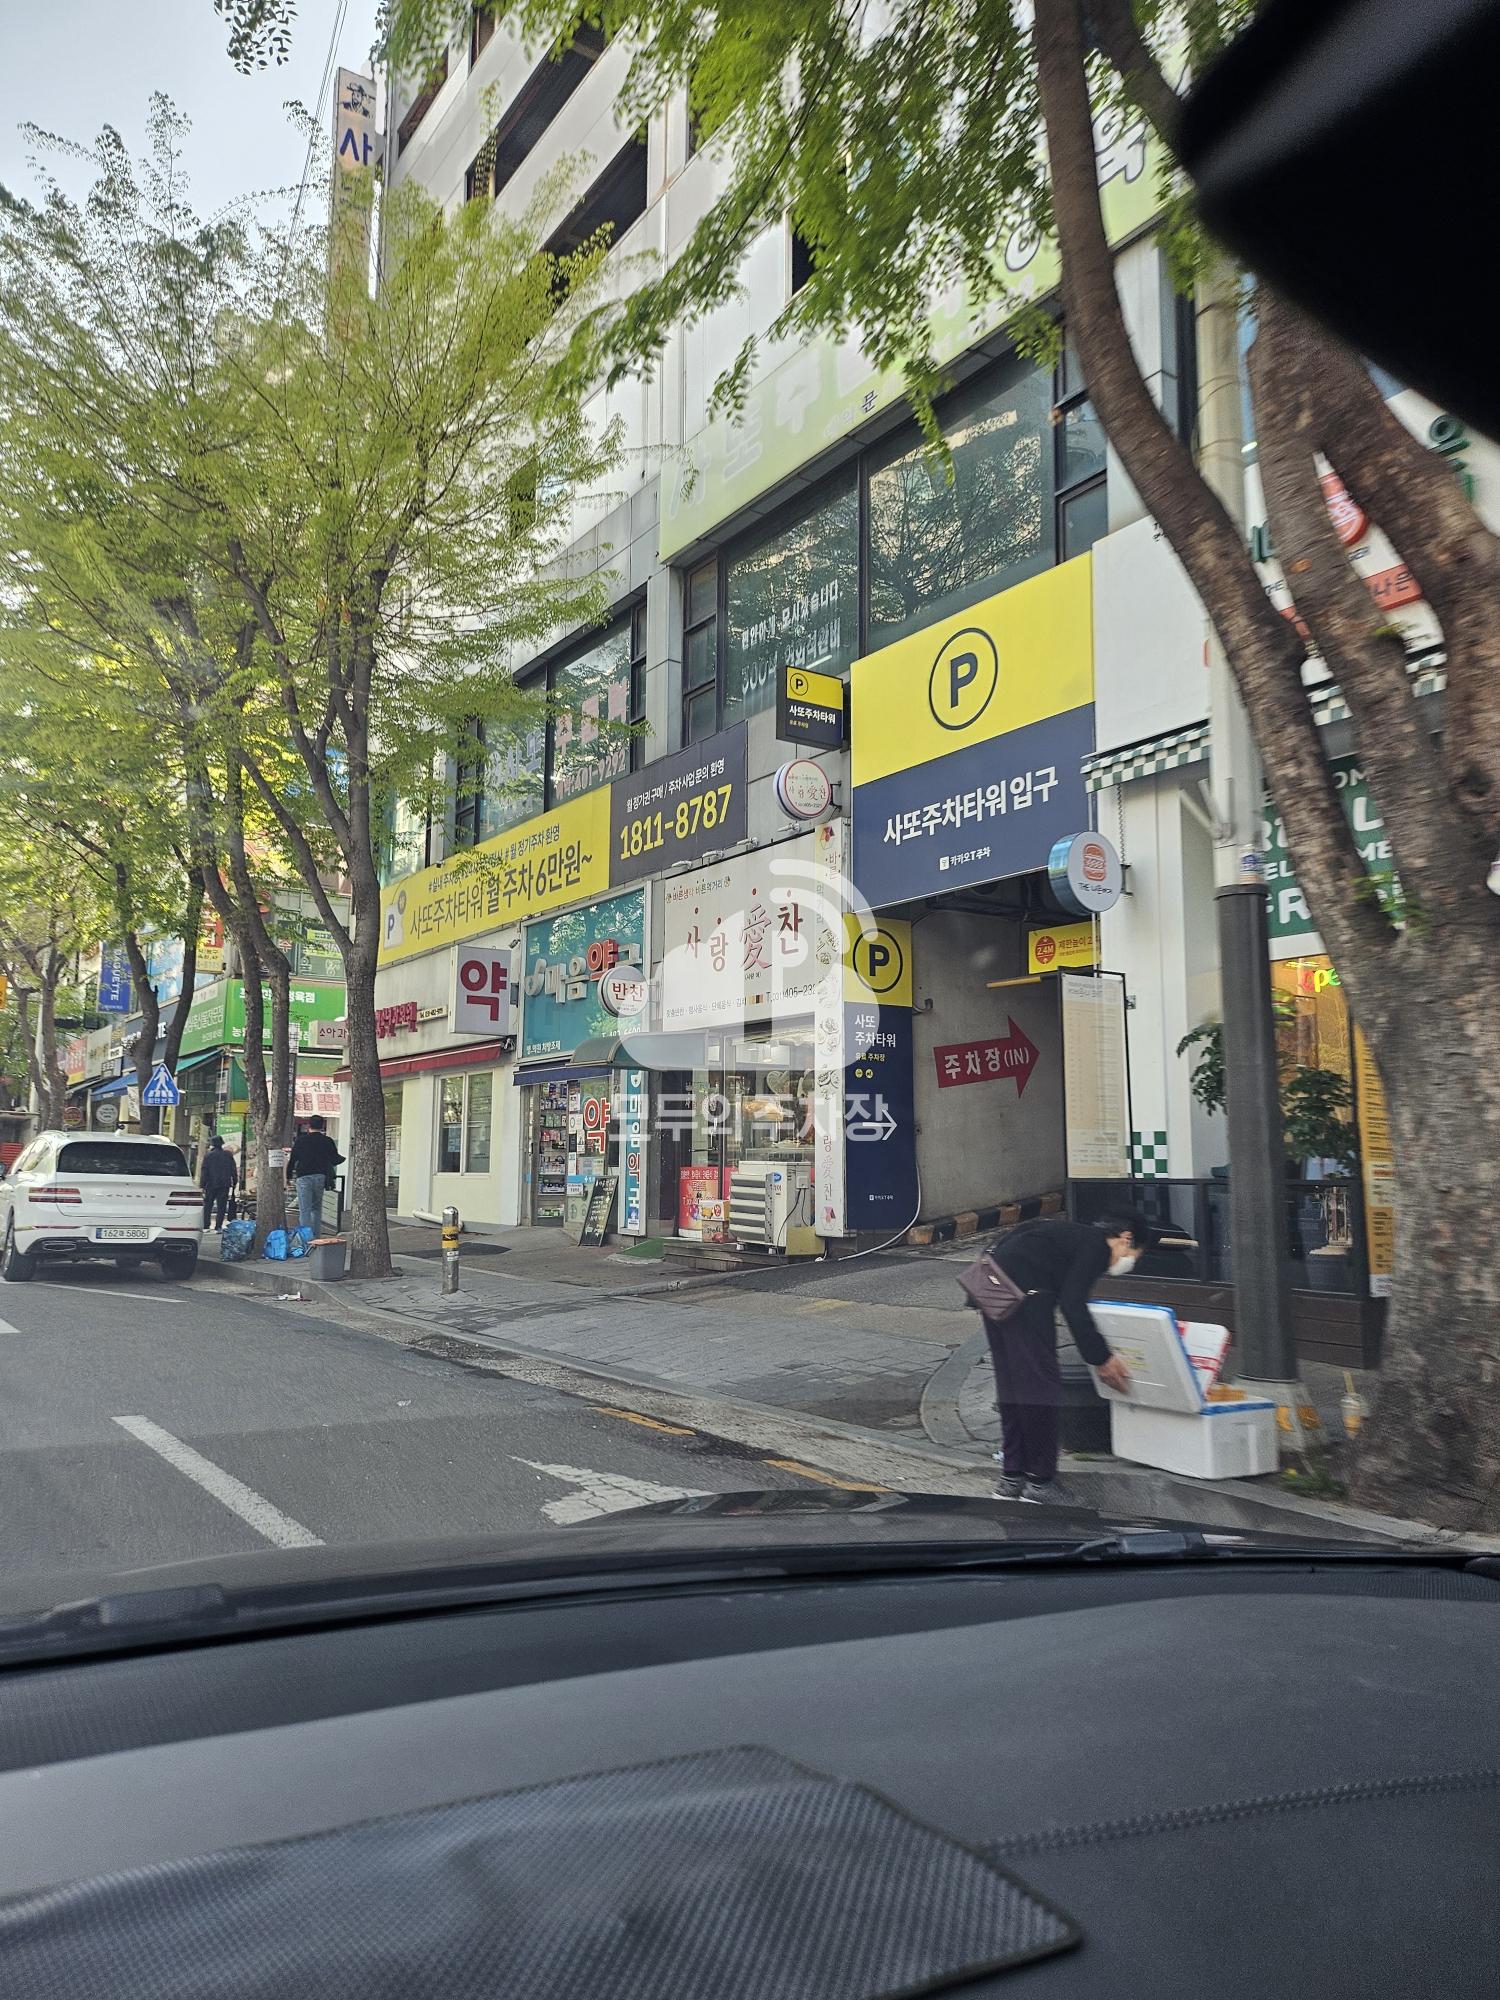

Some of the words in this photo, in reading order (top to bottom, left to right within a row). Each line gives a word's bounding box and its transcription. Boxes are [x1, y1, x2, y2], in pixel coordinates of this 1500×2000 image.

[950, 652, 979, 709] P
[789, 704, 836, 725] 사또주차타워
[883, 778, 1008, 846] 사또주차타워
[1009, 765, 1059, 810] 입구
[620, 783, 732, 860] 1811-8787
[544, 823, 560, 845] 환영
[410, 880, 484, 940] 사또주차타워
[535, 839, 593, 896] 6만원~
[868, 943, 889, 977] P
[460, 960, 508, 1021] 약
[612, 982, 644, 1002] 반찬
[854, 1013, 876, 1029] 사또
[854, 1031, 896, 1048] 주차타워
[867, 1053, 886, 1063] 주차장
[126, 1229, 148, 1238] 5806
